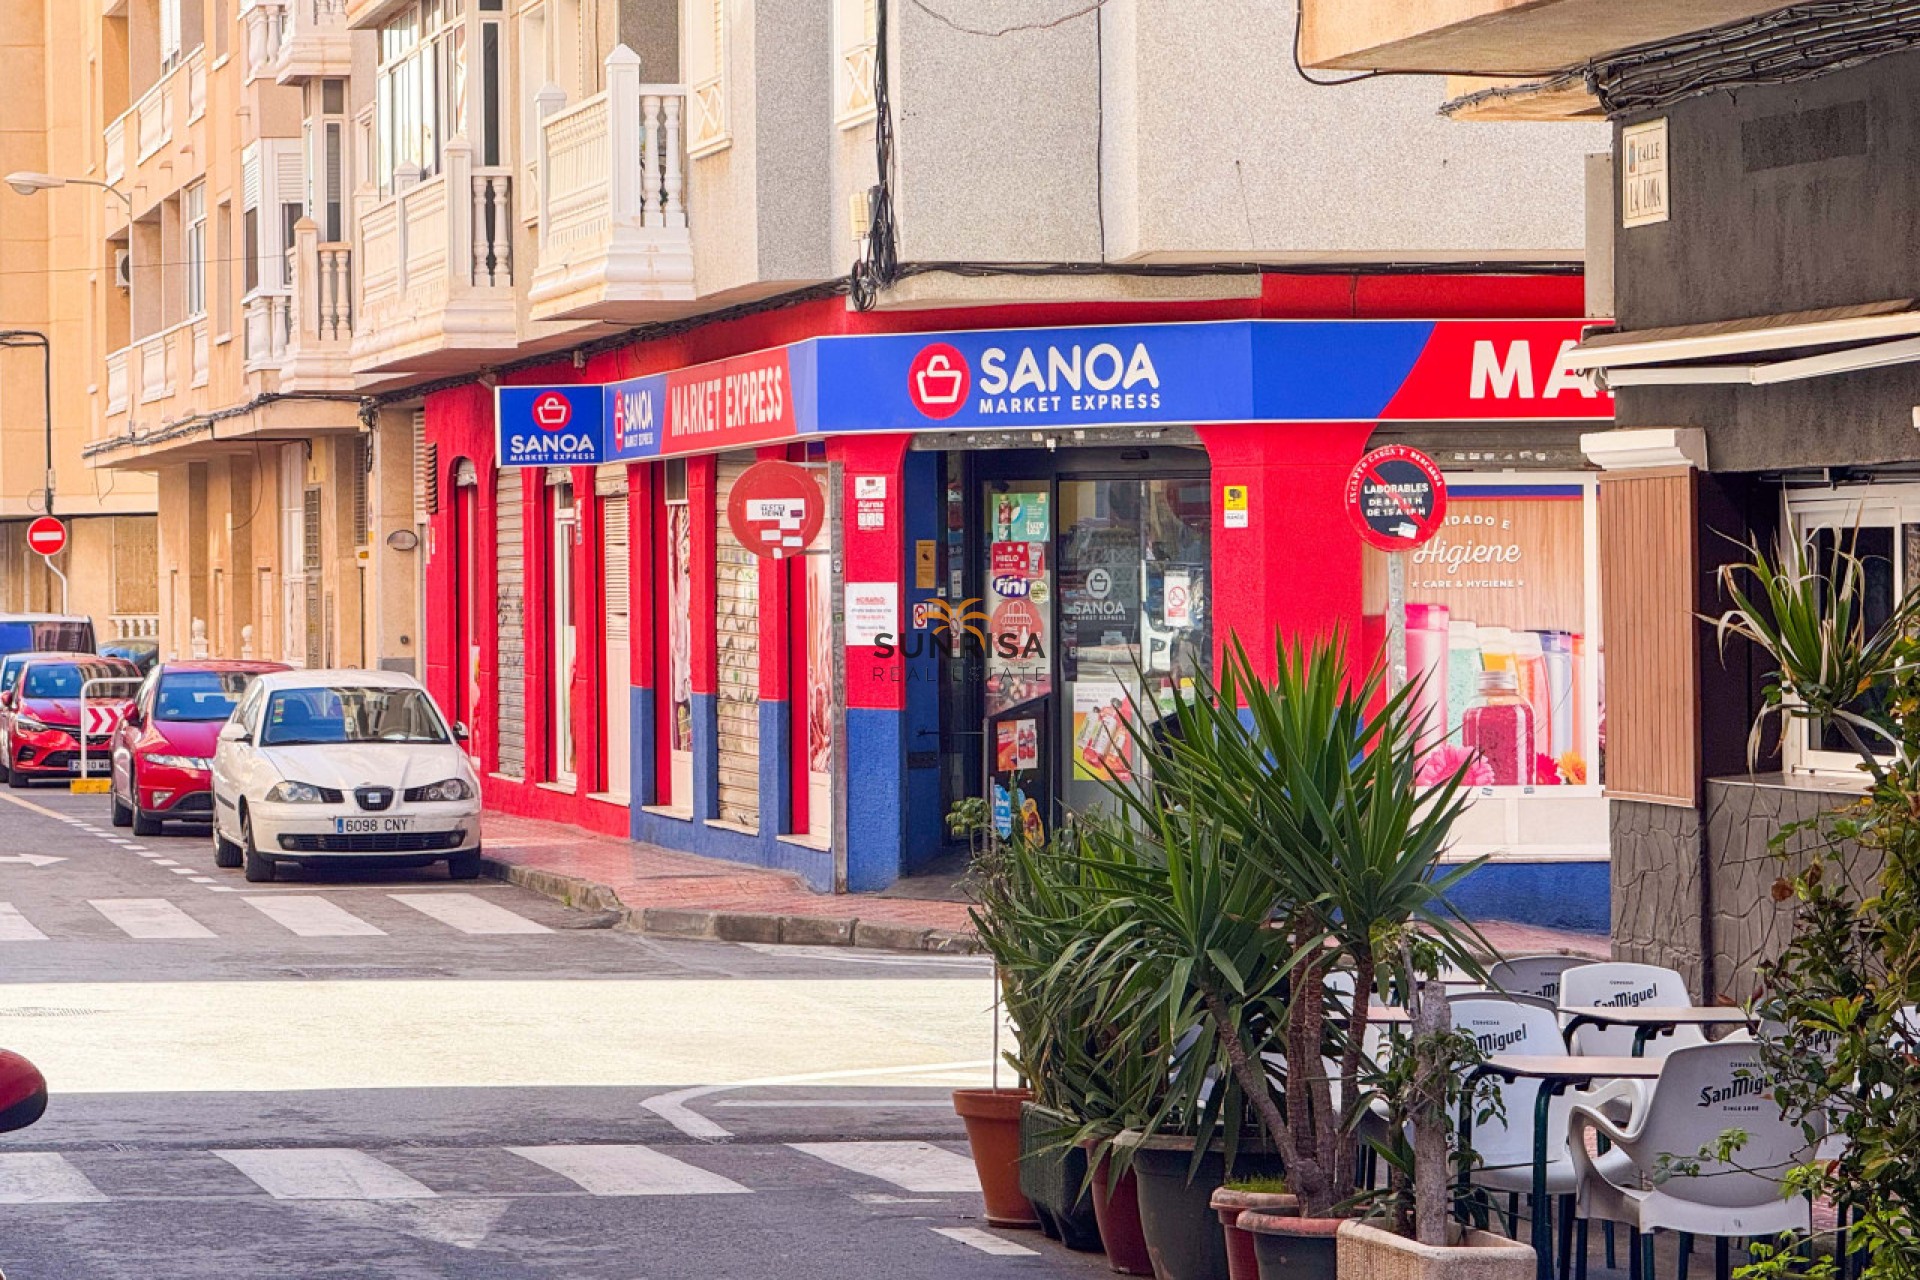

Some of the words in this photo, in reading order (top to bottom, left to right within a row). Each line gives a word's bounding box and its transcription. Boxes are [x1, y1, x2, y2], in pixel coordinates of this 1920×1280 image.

[1639, 141, 1661, 163] CALLE
[979, 342, 1160, 395] SANOA
[1469, 339, 1614, 399] MA
[671, 377, 722, 438] MARKET
[725, 364, 783, 428] EXPRESS
[979, 396, 1060, 414] MARKET
[1071, 393, 1161, 411] EXPRESS
[624, 390, 653, 433] SANOA
[510, 433, 595, 455] SANOA
[509, 453, 550, 462] MARKET
[553, 452, 595, 461] EXPRESS
[1364, 482, 1429, 495] LABORABLES
[1368, 498, 1383, 507] DE
[1415, 496, 1423, 505] H
[1366, 508, 1381, 517] DE
[1418, 506, 1426, 516] H
[1444, 514, 1495, 526] IDADO
[1502, 519, 1511, 530] E
[1412, 536, 1522, 574] Higiene
[1422, 580, 1452, 588] CARE
[1455, 580, 1463, 588] &
[1466, 580, 1515, 588] HYGIENE
[1073, 600, 1126, 615] SANOA
[346, 819, 378, 832] 6098
[385, 818, 408, 831] CNY
